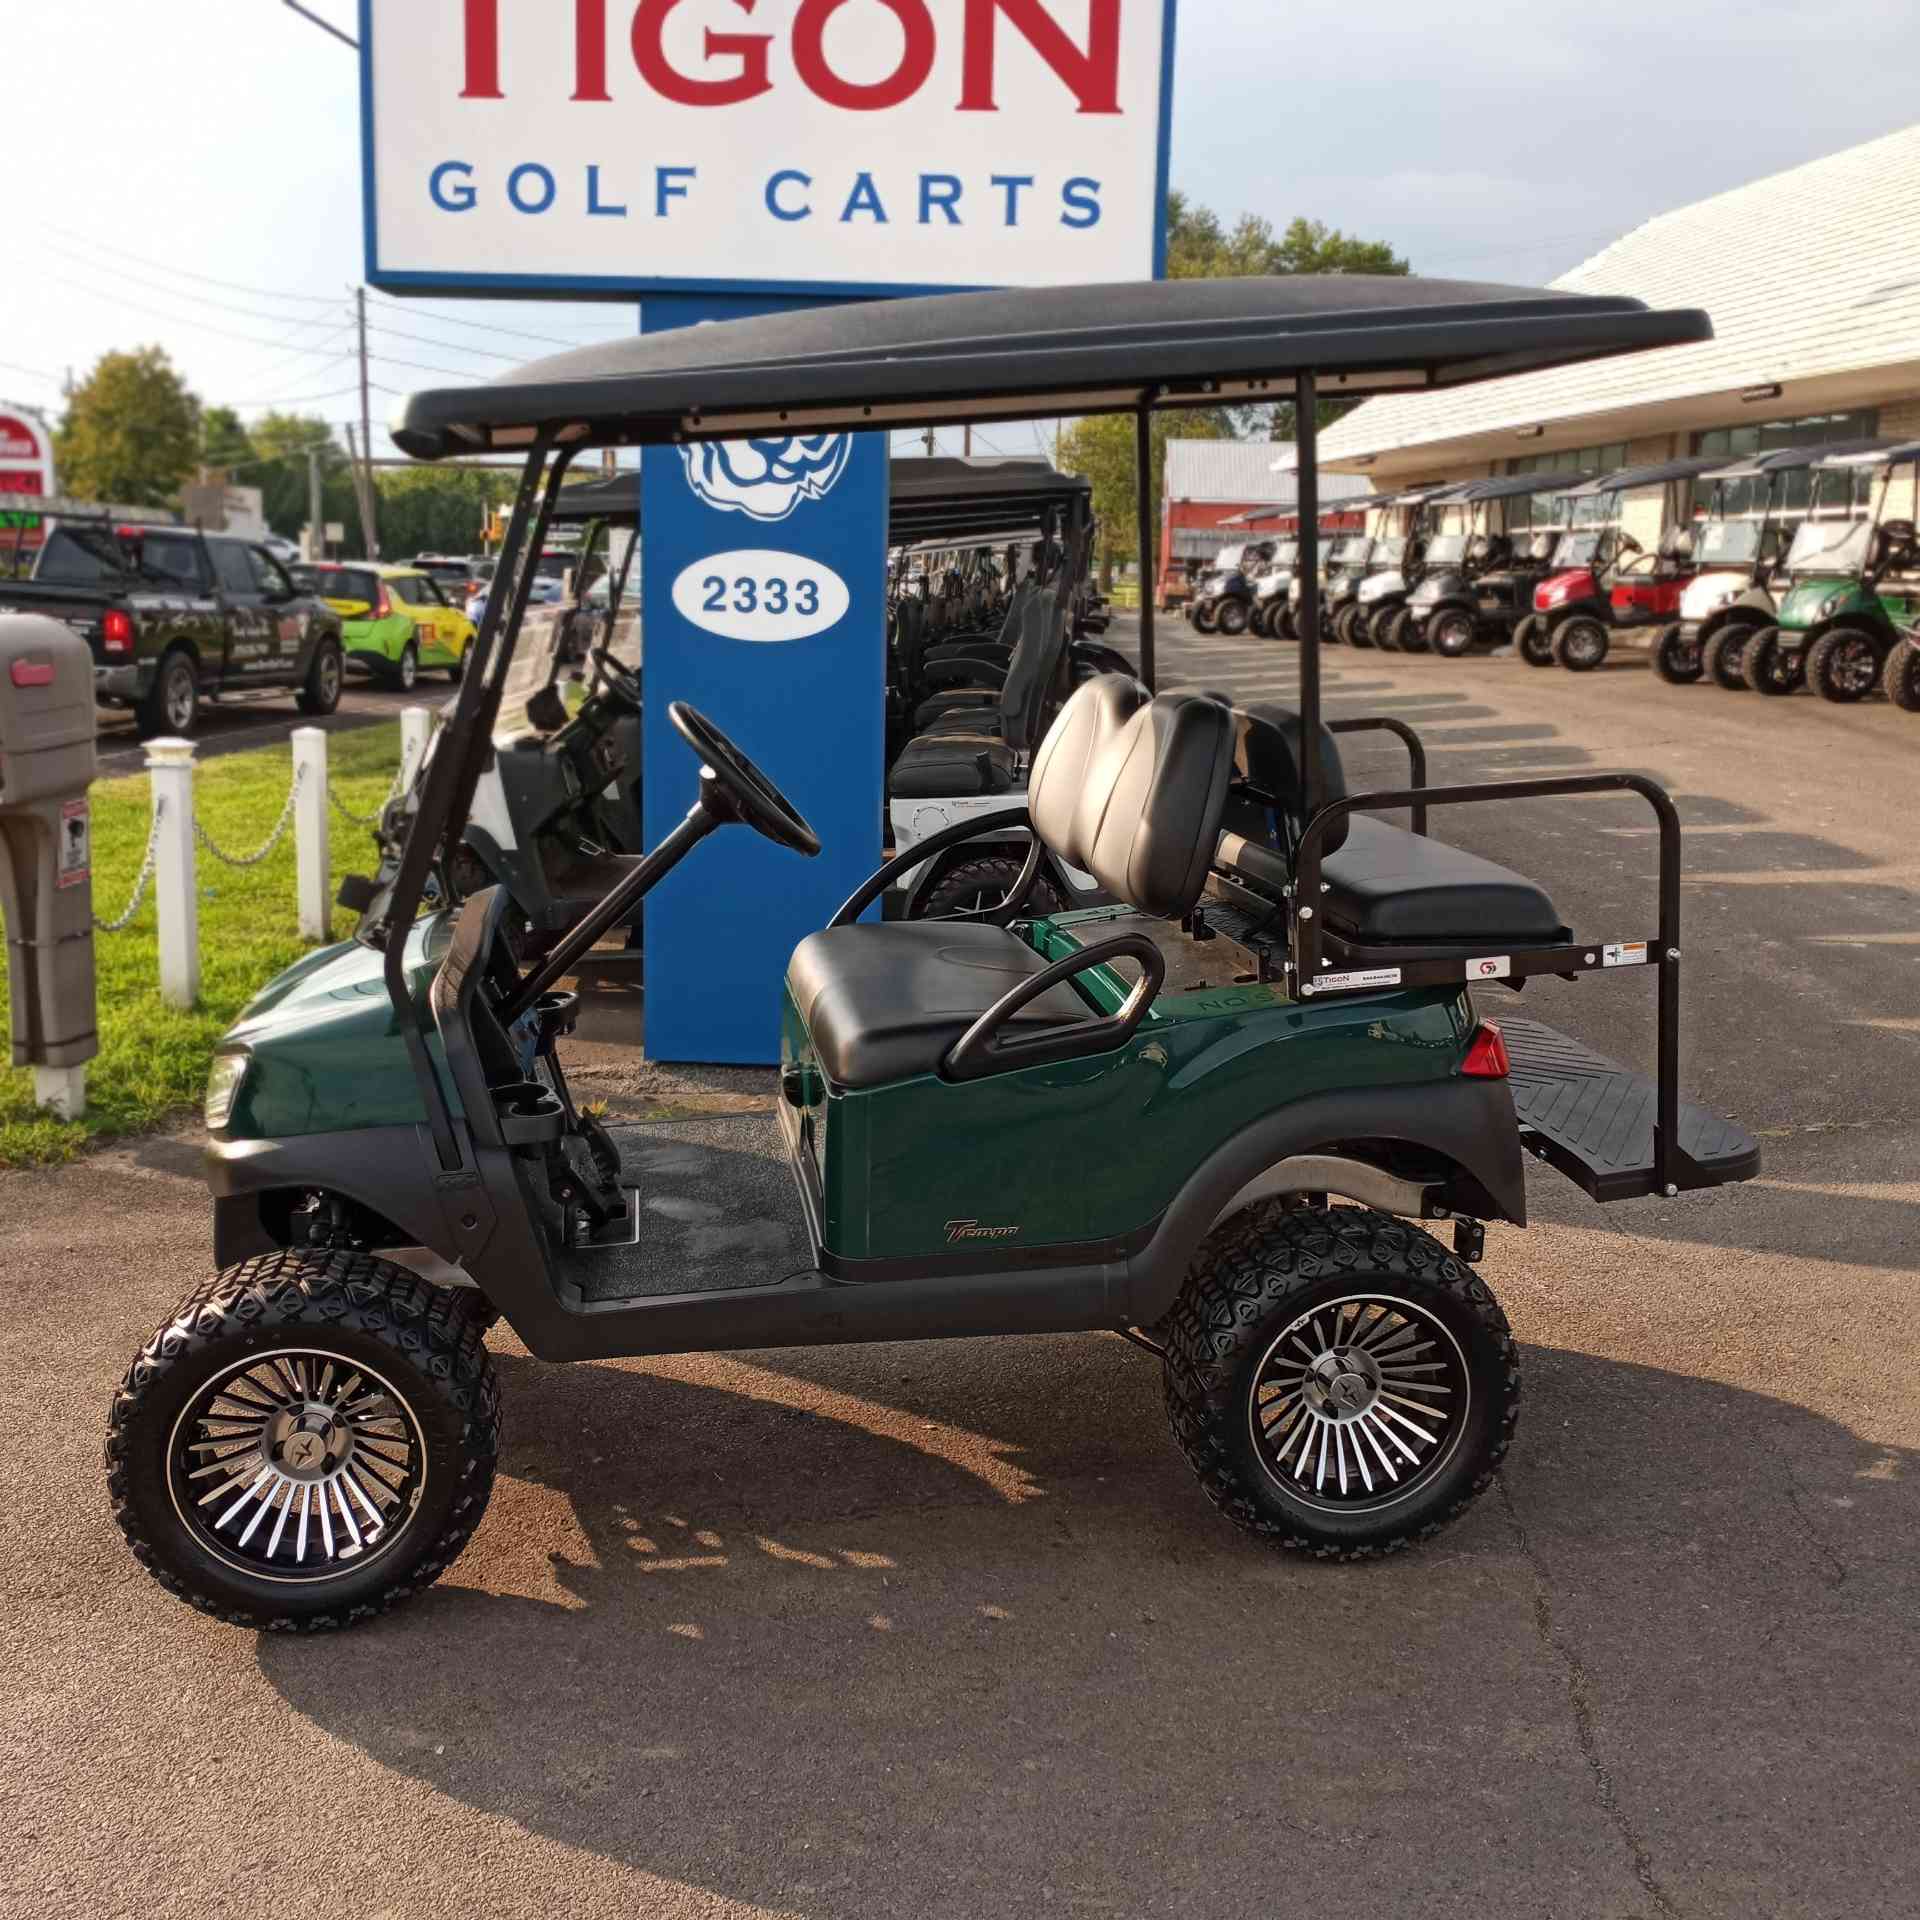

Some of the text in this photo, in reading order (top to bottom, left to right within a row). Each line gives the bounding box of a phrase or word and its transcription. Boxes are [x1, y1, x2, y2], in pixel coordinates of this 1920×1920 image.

[429, 160, 1102, 229] GOLF CARTS
[702, 575, 819, 615] 2333
[943, 1219, 1020, 1242] Tempo
